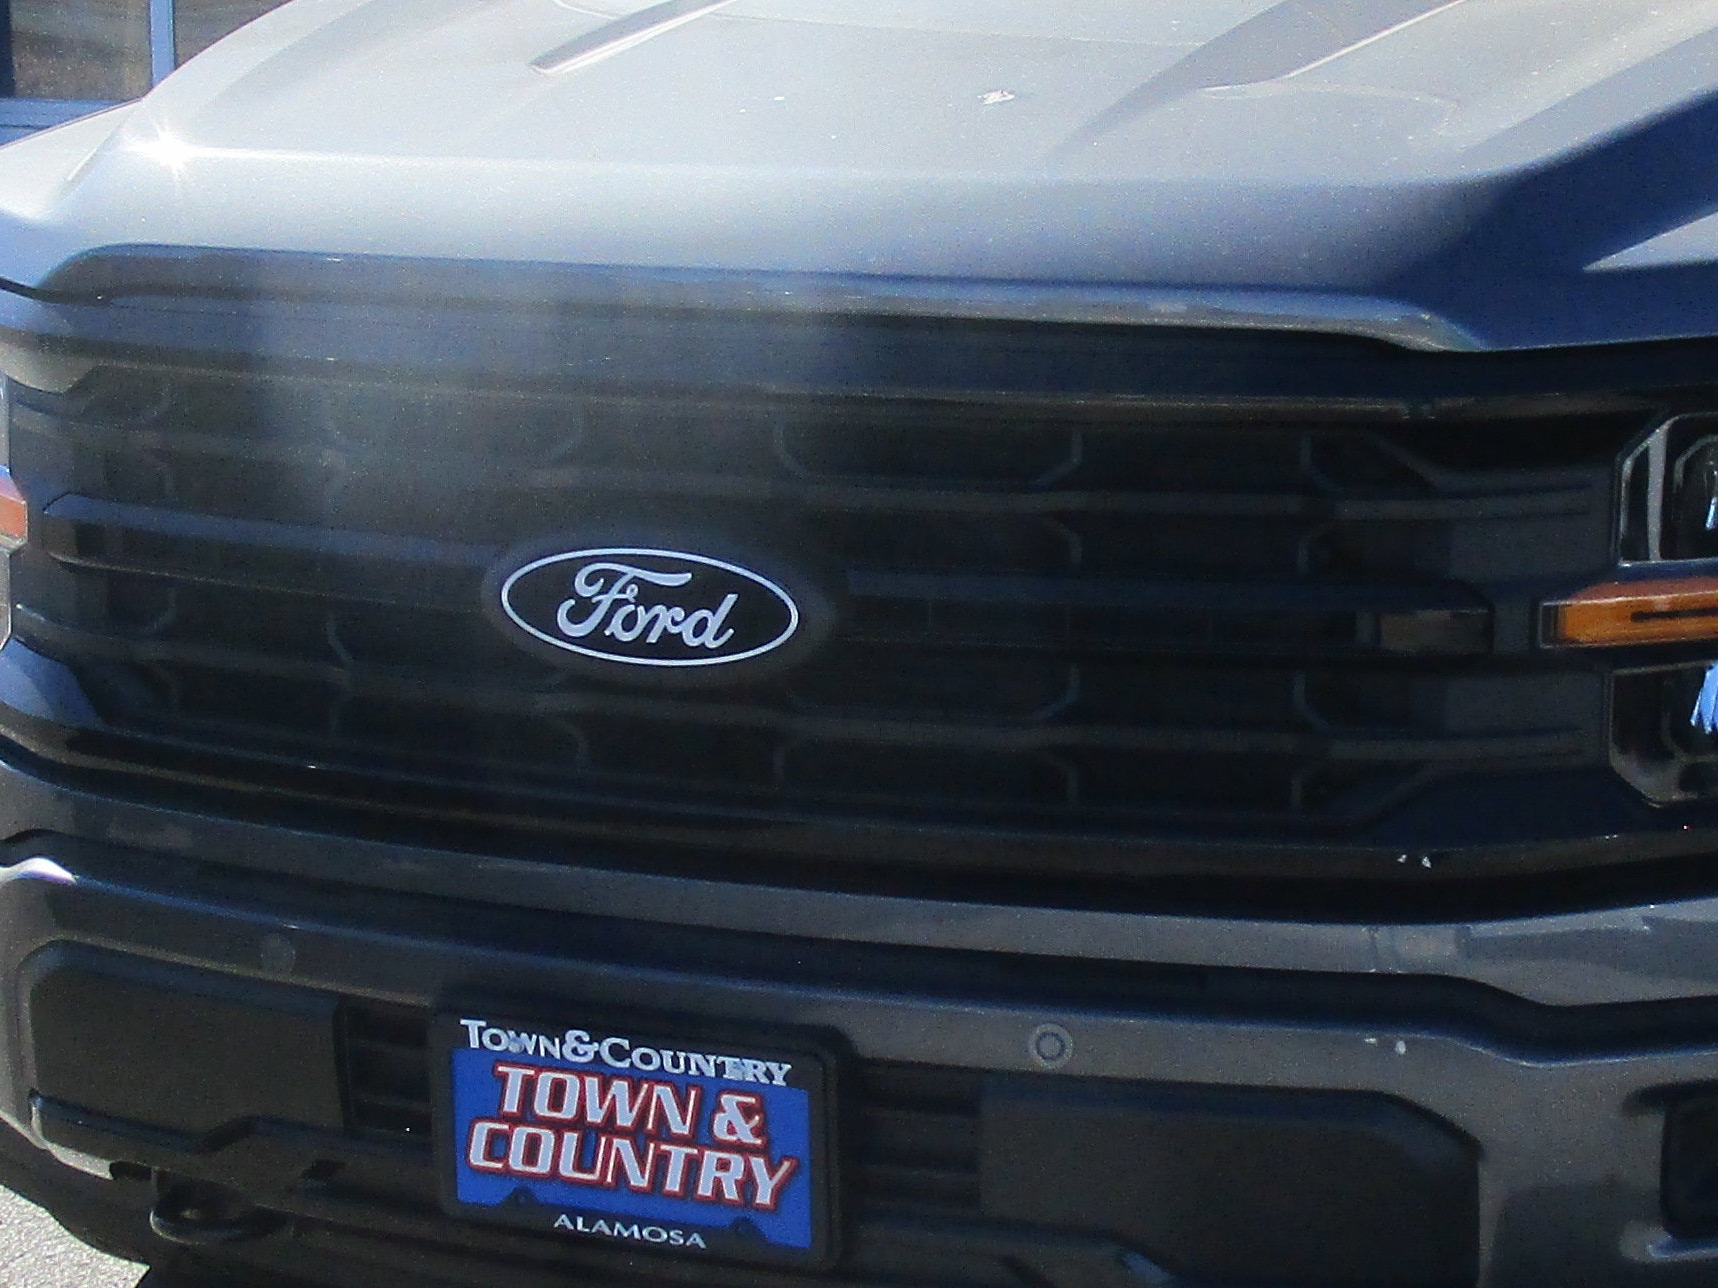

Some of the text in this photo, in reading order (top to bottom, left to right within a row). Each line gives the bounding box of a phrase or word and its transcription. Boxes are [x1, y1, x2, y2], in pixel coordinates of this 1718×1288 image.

[557, 563, 738, 648] Ford
[494, 1062, 765, 1149] TOWN &
[466, 1118, 797, 1211] COUNTRY
[554, 1214, 707, 1249] ALAMOSA
